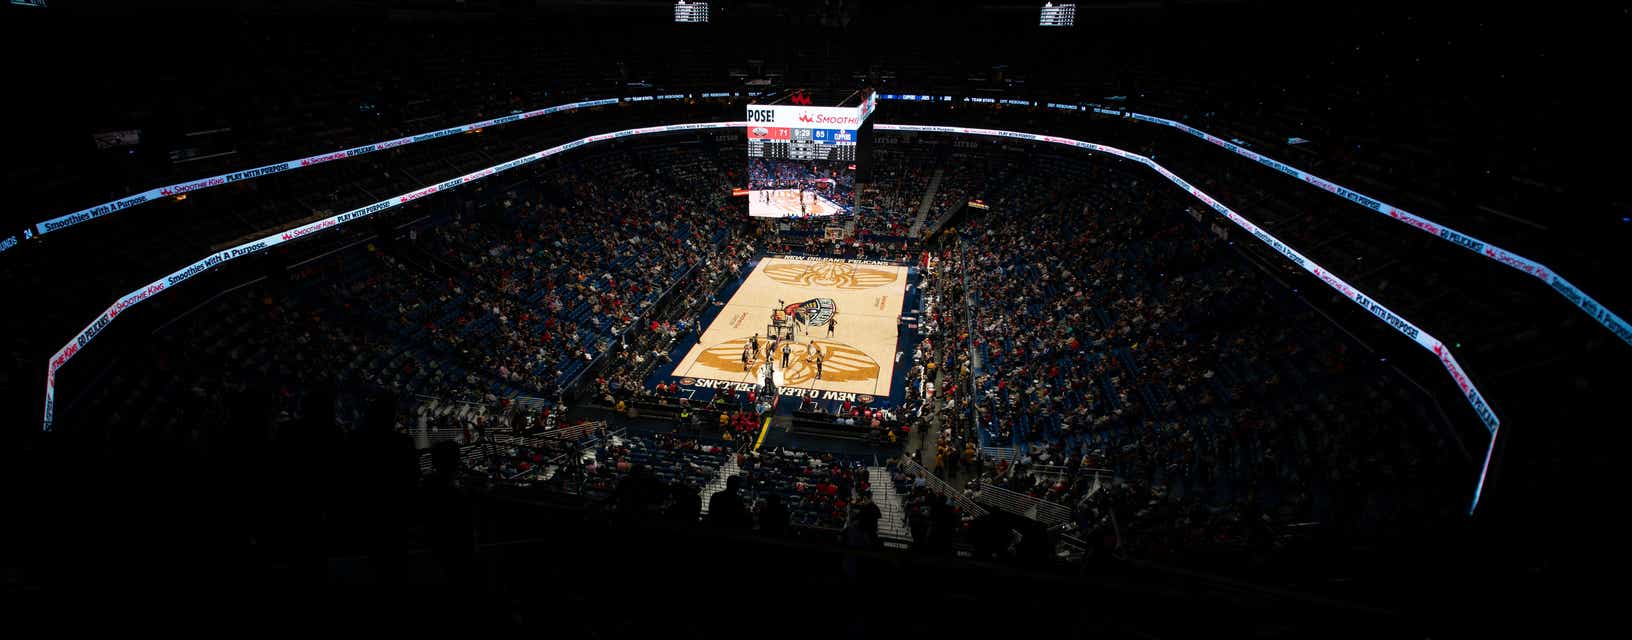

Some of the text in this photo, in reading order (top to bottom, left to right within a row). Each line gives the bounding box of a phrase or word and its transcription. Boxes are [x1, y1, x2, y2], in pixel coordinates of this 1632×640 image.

[44, 212, 90, 232] Smoothies
[90, 206, 110, 218] With
[111, 203, 118, 213] A
[168, 264, 205, 286] Smoothies
[204, 254, 222, 267] With
[224, 252, 230, 260] A
